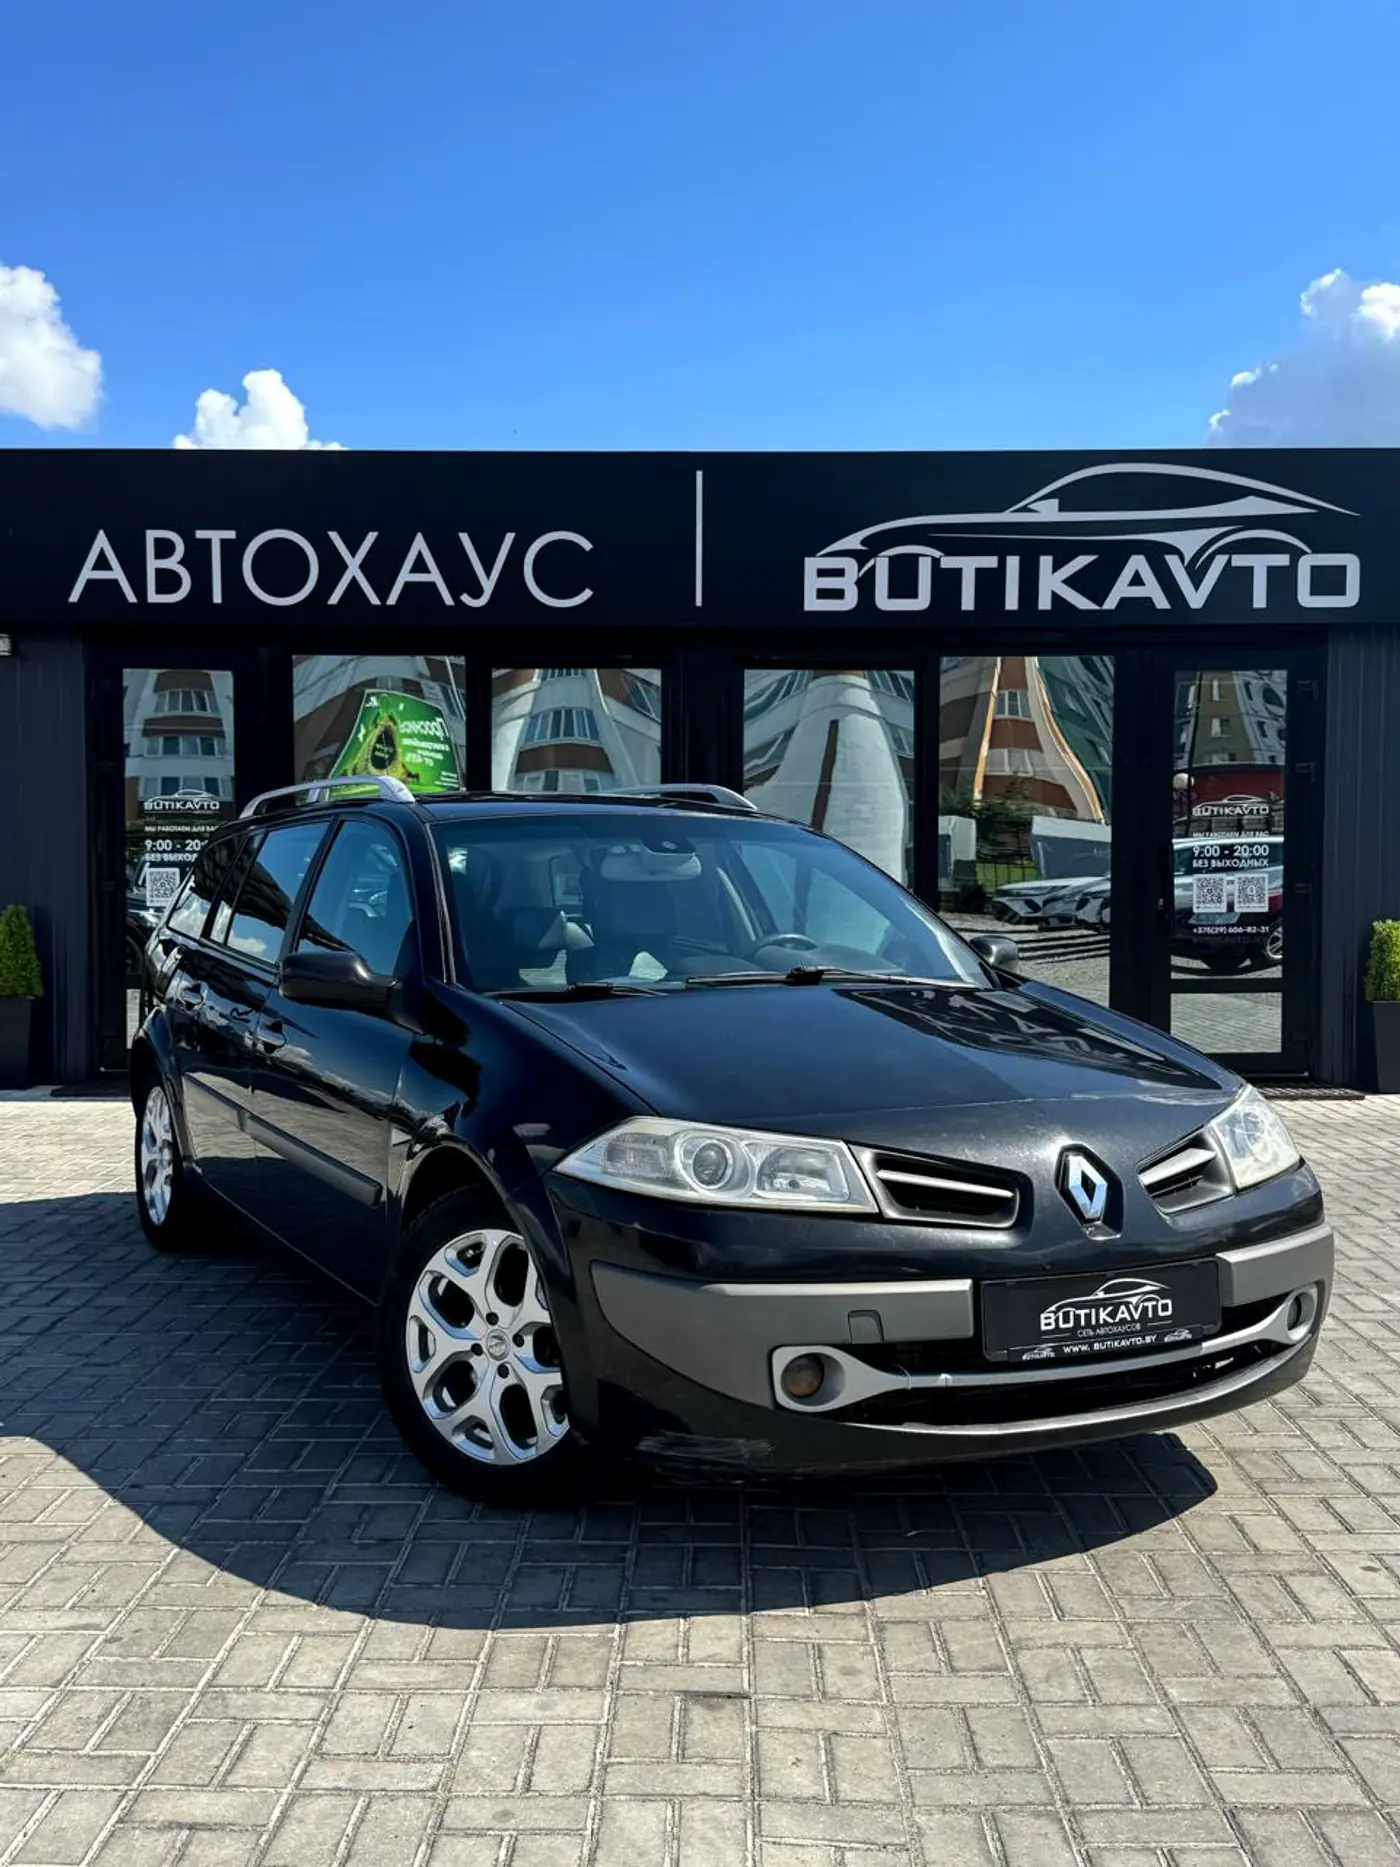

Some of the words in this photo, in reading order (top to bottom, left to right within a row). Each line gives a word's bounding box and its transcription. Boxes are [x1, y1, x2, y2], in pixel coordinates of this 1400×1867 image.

[68, 529, 594, 608] АВТОХАУС
[804, 552, 1361, 612] BUTIKAVTO
[144, 800, 220, 810] BUTIKAVTO
[1192, 805, 1270, 816] BUTIKAVTO
[144, 839, 172, 851] 9:00
[1193, 844, 1220, 857] 9:00
[1233, 844, 1269, 856] 20:00
[144, 853, 160, 862] БЕЗ
[1193, 859, 1208, 868] БЕЗ
[1210, 858, 1269, 868] ВЫХОДНЫХ
[1040, 1299, 1173, 1331] BUTIKAVTO
[1063, 1344, 1091, 1354] WWW.
